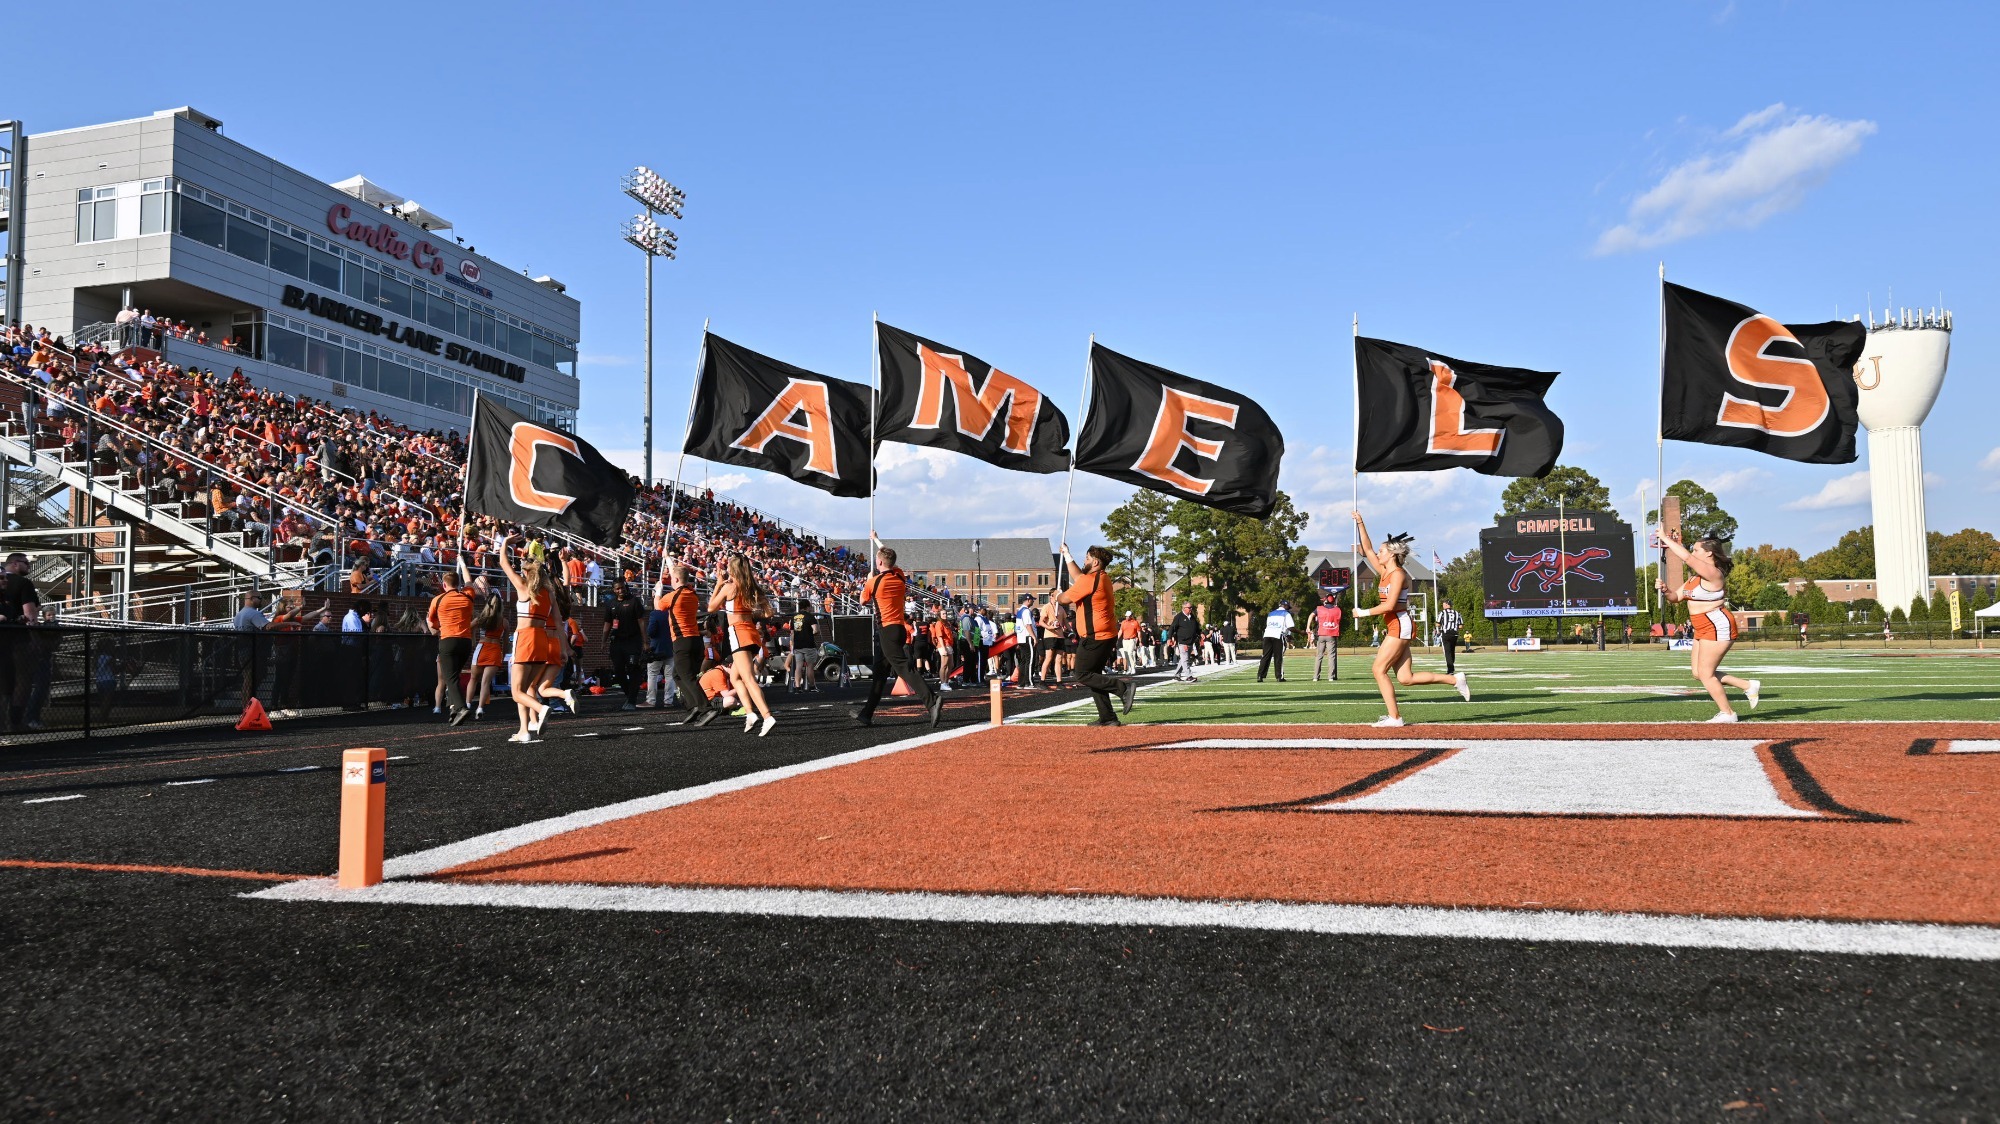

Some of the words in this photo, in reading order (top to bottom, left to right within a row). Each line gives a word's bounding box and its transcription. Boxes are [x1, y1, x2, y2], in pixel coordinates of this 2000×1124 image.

[327, 203, 410, 260] Carlie
[413, 240, 444, 276] C's
[281, 284, 444, 356] BARKER-LANE
[445, 342, 526, 384] STADIUM
[1717, 313, 1829, 437] S
[1853, 355, 1882, 390] U
[729, 376, 840, 480] A
[908, 341, 1042, 456] M
[1130, 384, 1239, 495] E
[1426, 357, 1506, 456] L
[508, 420, 586, 514] C
[1517, 518, 1595, 534] CAMPBELL
[1321, 569, 1349, 586] 2:09
[1951, 595, 1960, 628] PHOTOS
